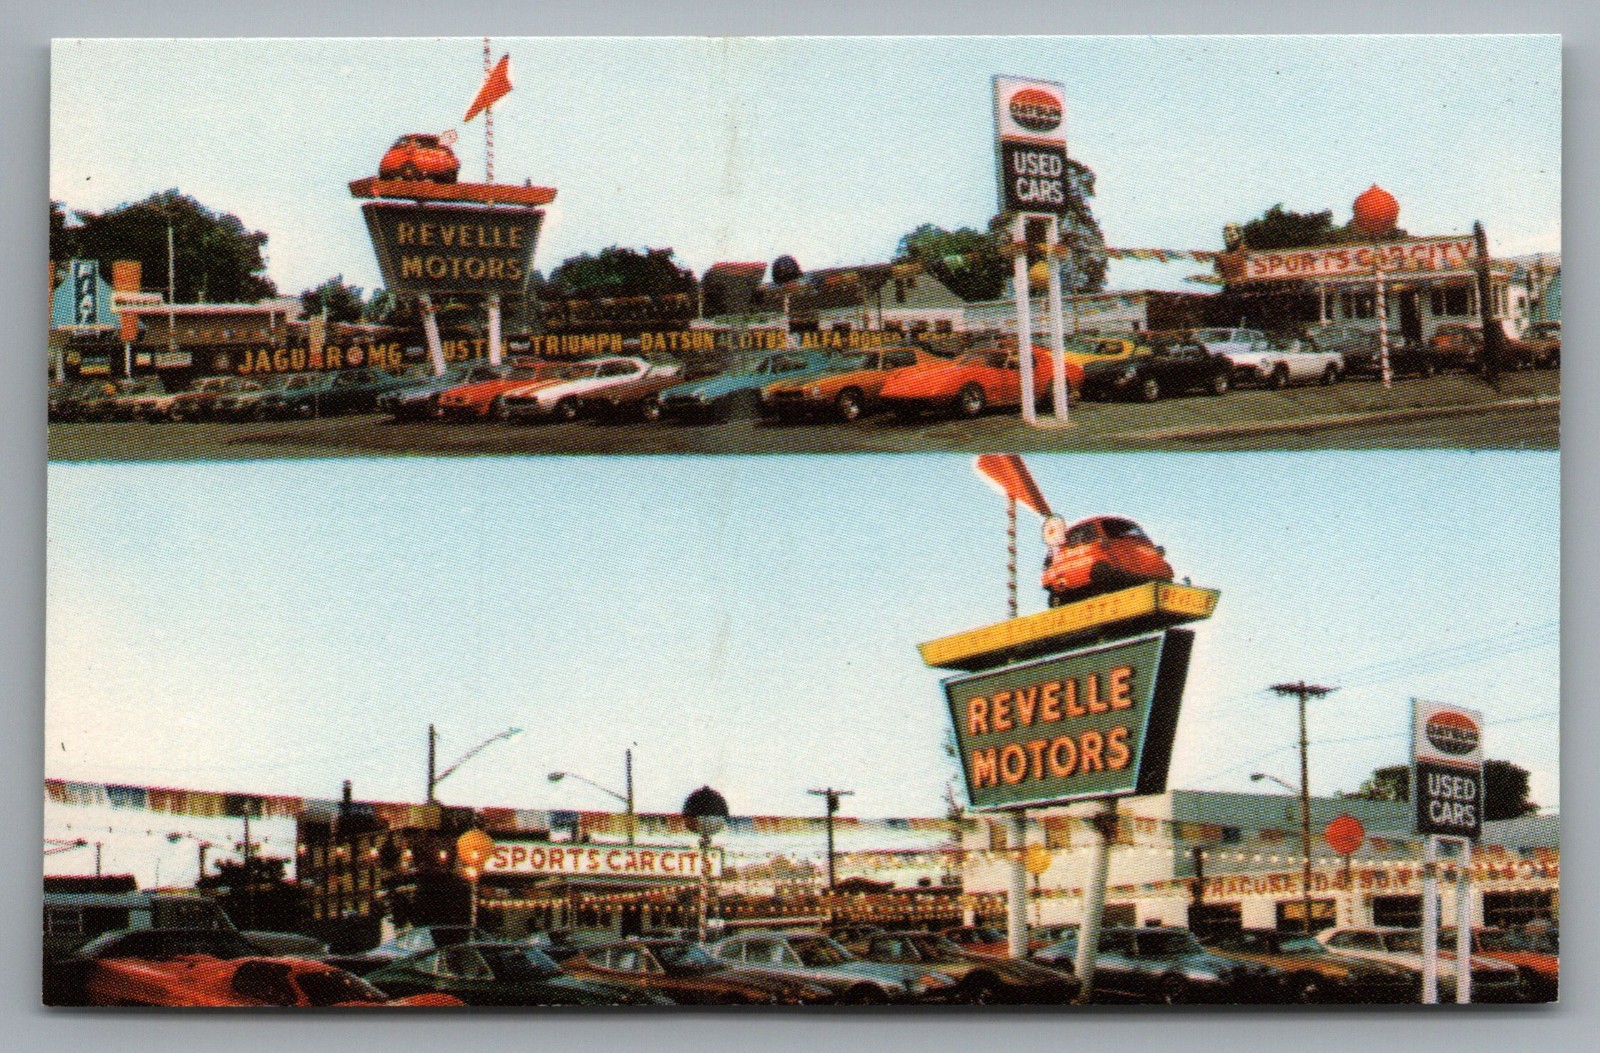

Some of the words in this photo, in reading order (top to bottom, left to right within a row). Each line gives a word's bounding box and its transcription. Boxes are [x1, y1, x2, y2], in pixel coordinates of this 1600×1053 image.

[1014, 151, 1062, 176] USED
[1016, 177, 1063, 203] CARS
[397, 222, 524, 248] REVELLE
[400, 255, 524, 279] MOTORS
[1254, 249, 1350, 274] SPORTS
[427, 338, 508, 363] USTN
[529, 332, 622, 355] TRIUMPH
[639, 330, 715, 352] DATSUN
[967, 665, 1132, 736] REVELLE
[971, 726, 1130, 789] MOTORS
[1429, 772, 1476, 800] USED
[1430, 800, 1476, 826] CARS
[492, 847, 600, 870] SPORTS
[1314, 867, 1412, 892] DASUN
